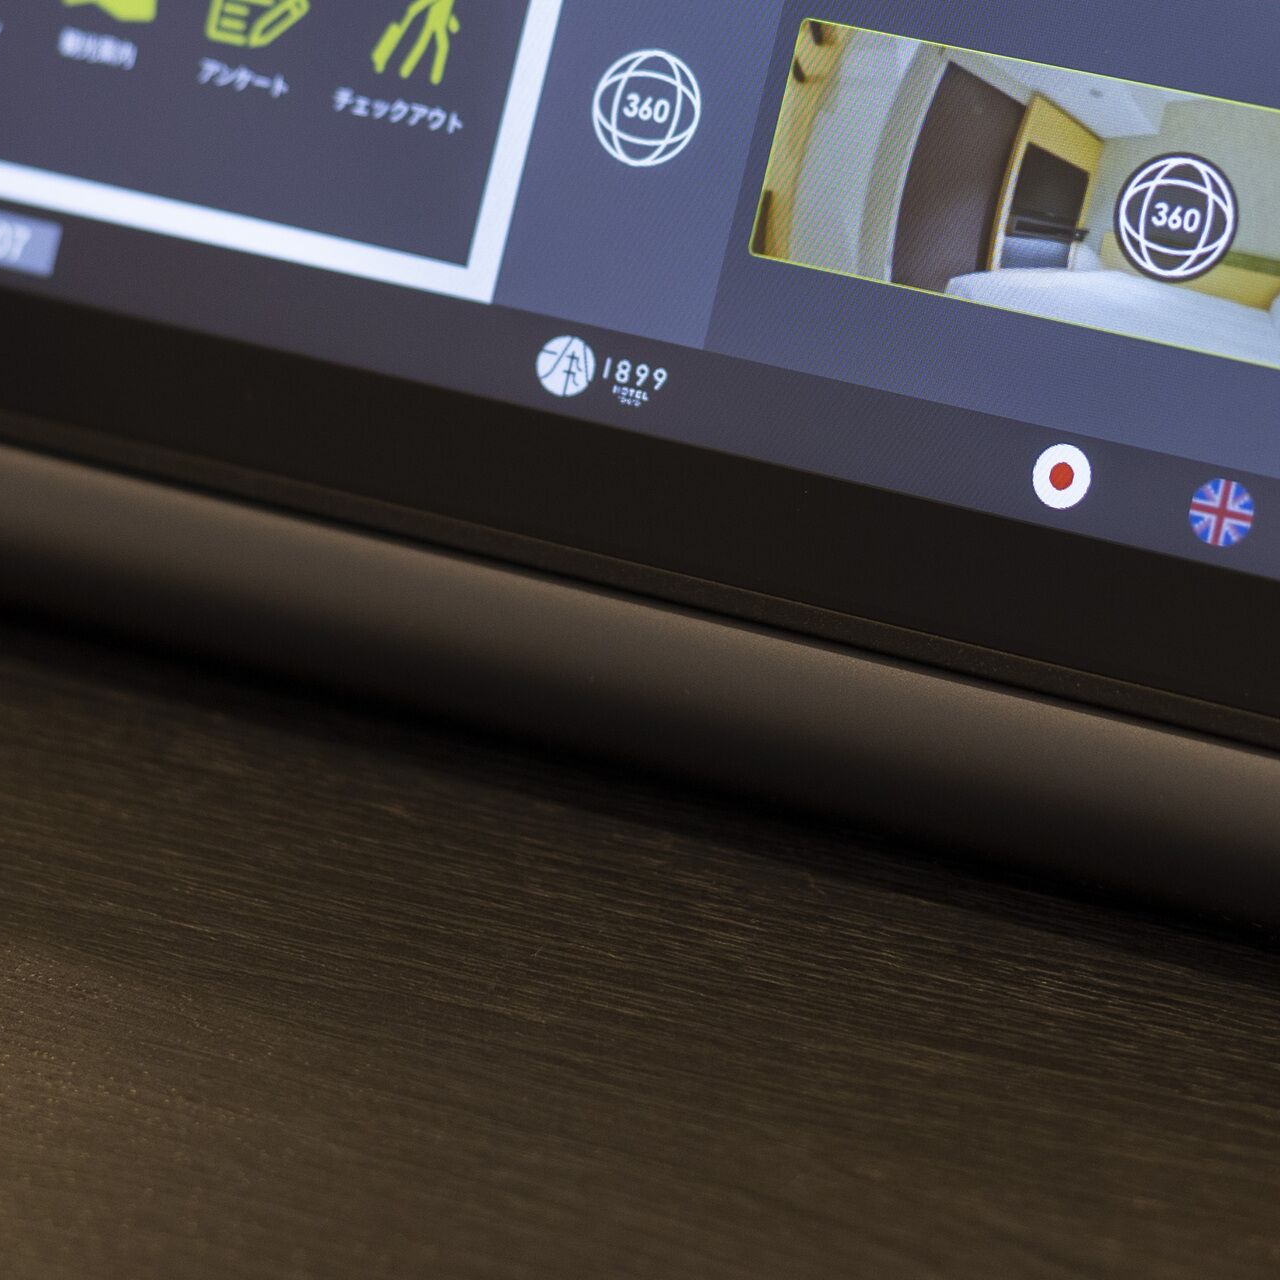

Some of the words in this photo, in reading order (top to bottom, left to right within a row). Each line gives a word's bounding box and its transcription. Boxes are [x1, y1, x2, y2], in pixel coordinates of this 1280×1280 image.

[197, 57, 290, 99] アンケート
[333, 86, 464, 135] チェックアウト
[622, 92, 671, 124] 360
[1151, 201, 1201, 233] 360
[602, 357, 669, 391] 1899
